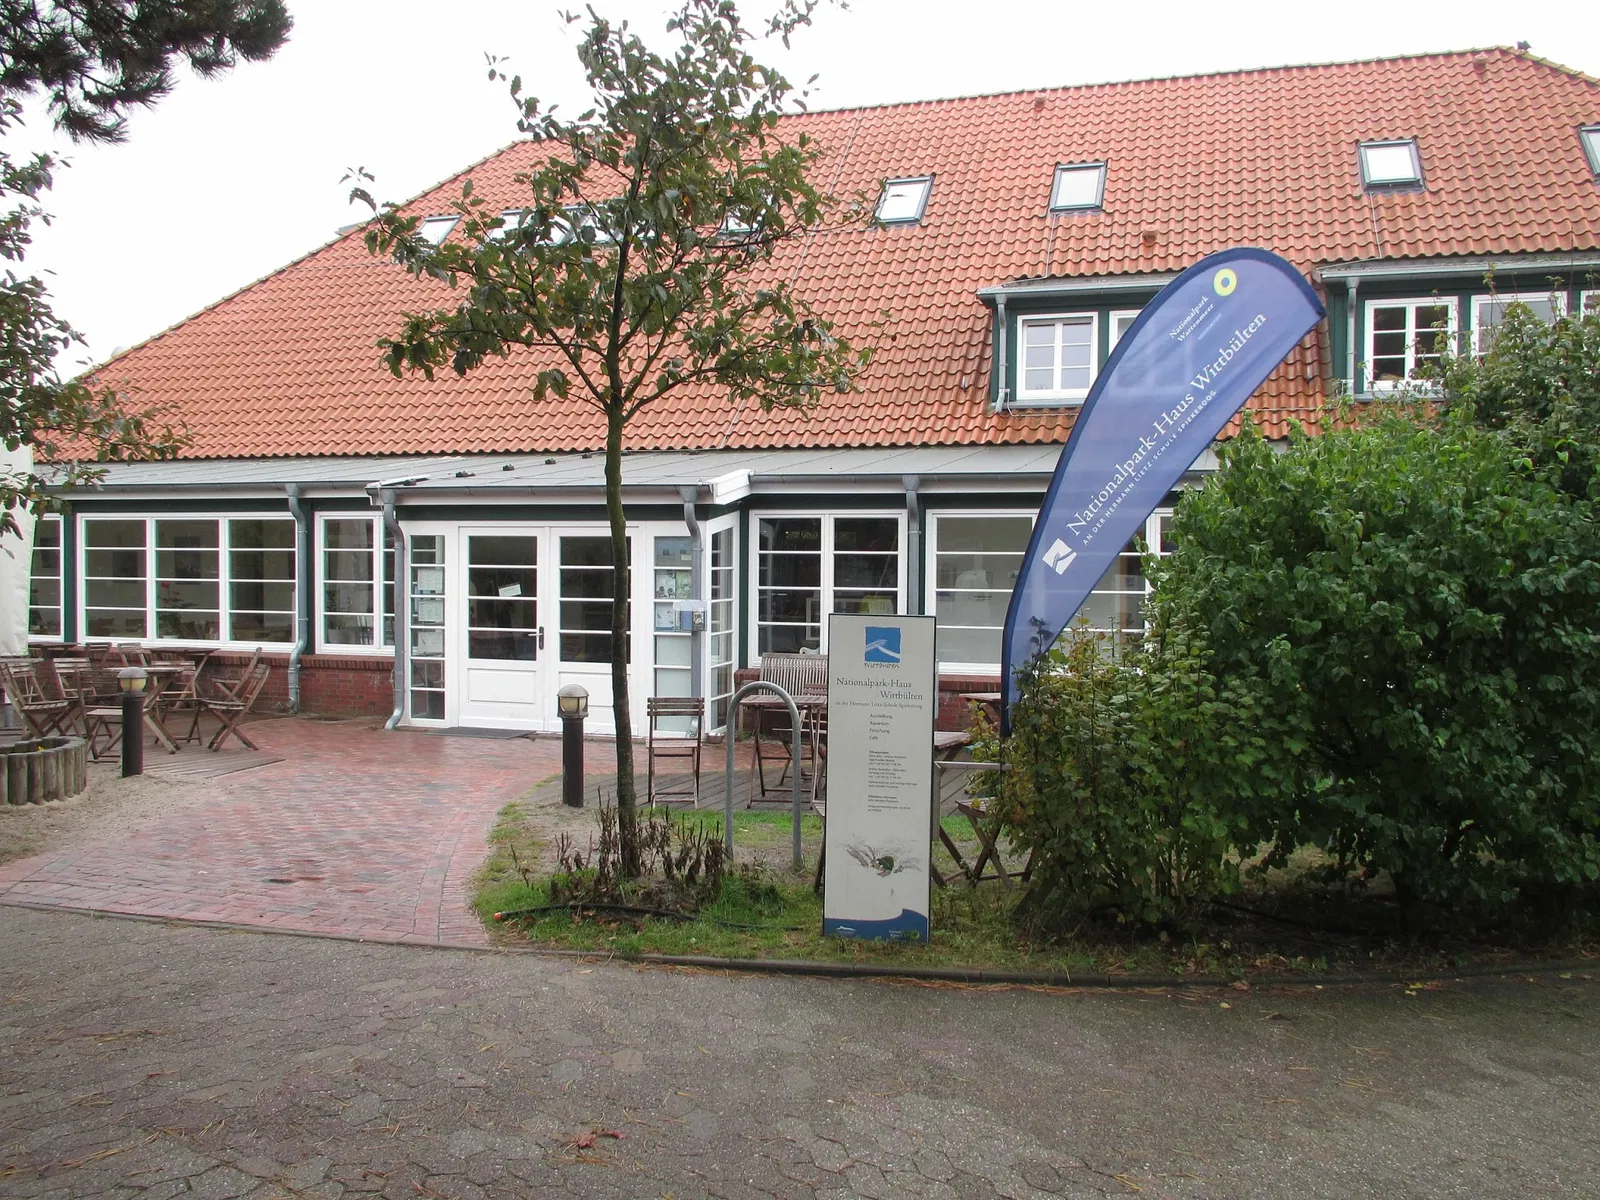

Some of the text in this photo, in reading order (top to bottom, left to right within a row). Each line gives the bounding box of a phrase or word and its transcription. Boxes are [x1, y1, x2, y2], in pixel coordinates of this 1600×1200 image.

[1169, 295, 1209, 339] Nationalpark
[1177, 303, 1214, 342] Wattenmeer
[1066, 313, 1267, 536] Nationalpark-Haus Wittbülten
[1083, 534, 1093, 545] AN
[1092, 517, 1106, 533] DER
[1105, 482, 1134, 517] HERMANN
[1177, 390, 1216, 433] SPIEKEROOG
[836, 677, 912, 689] Nationalpark-Haus
[880, 690, 923, 700] Wittbülten
